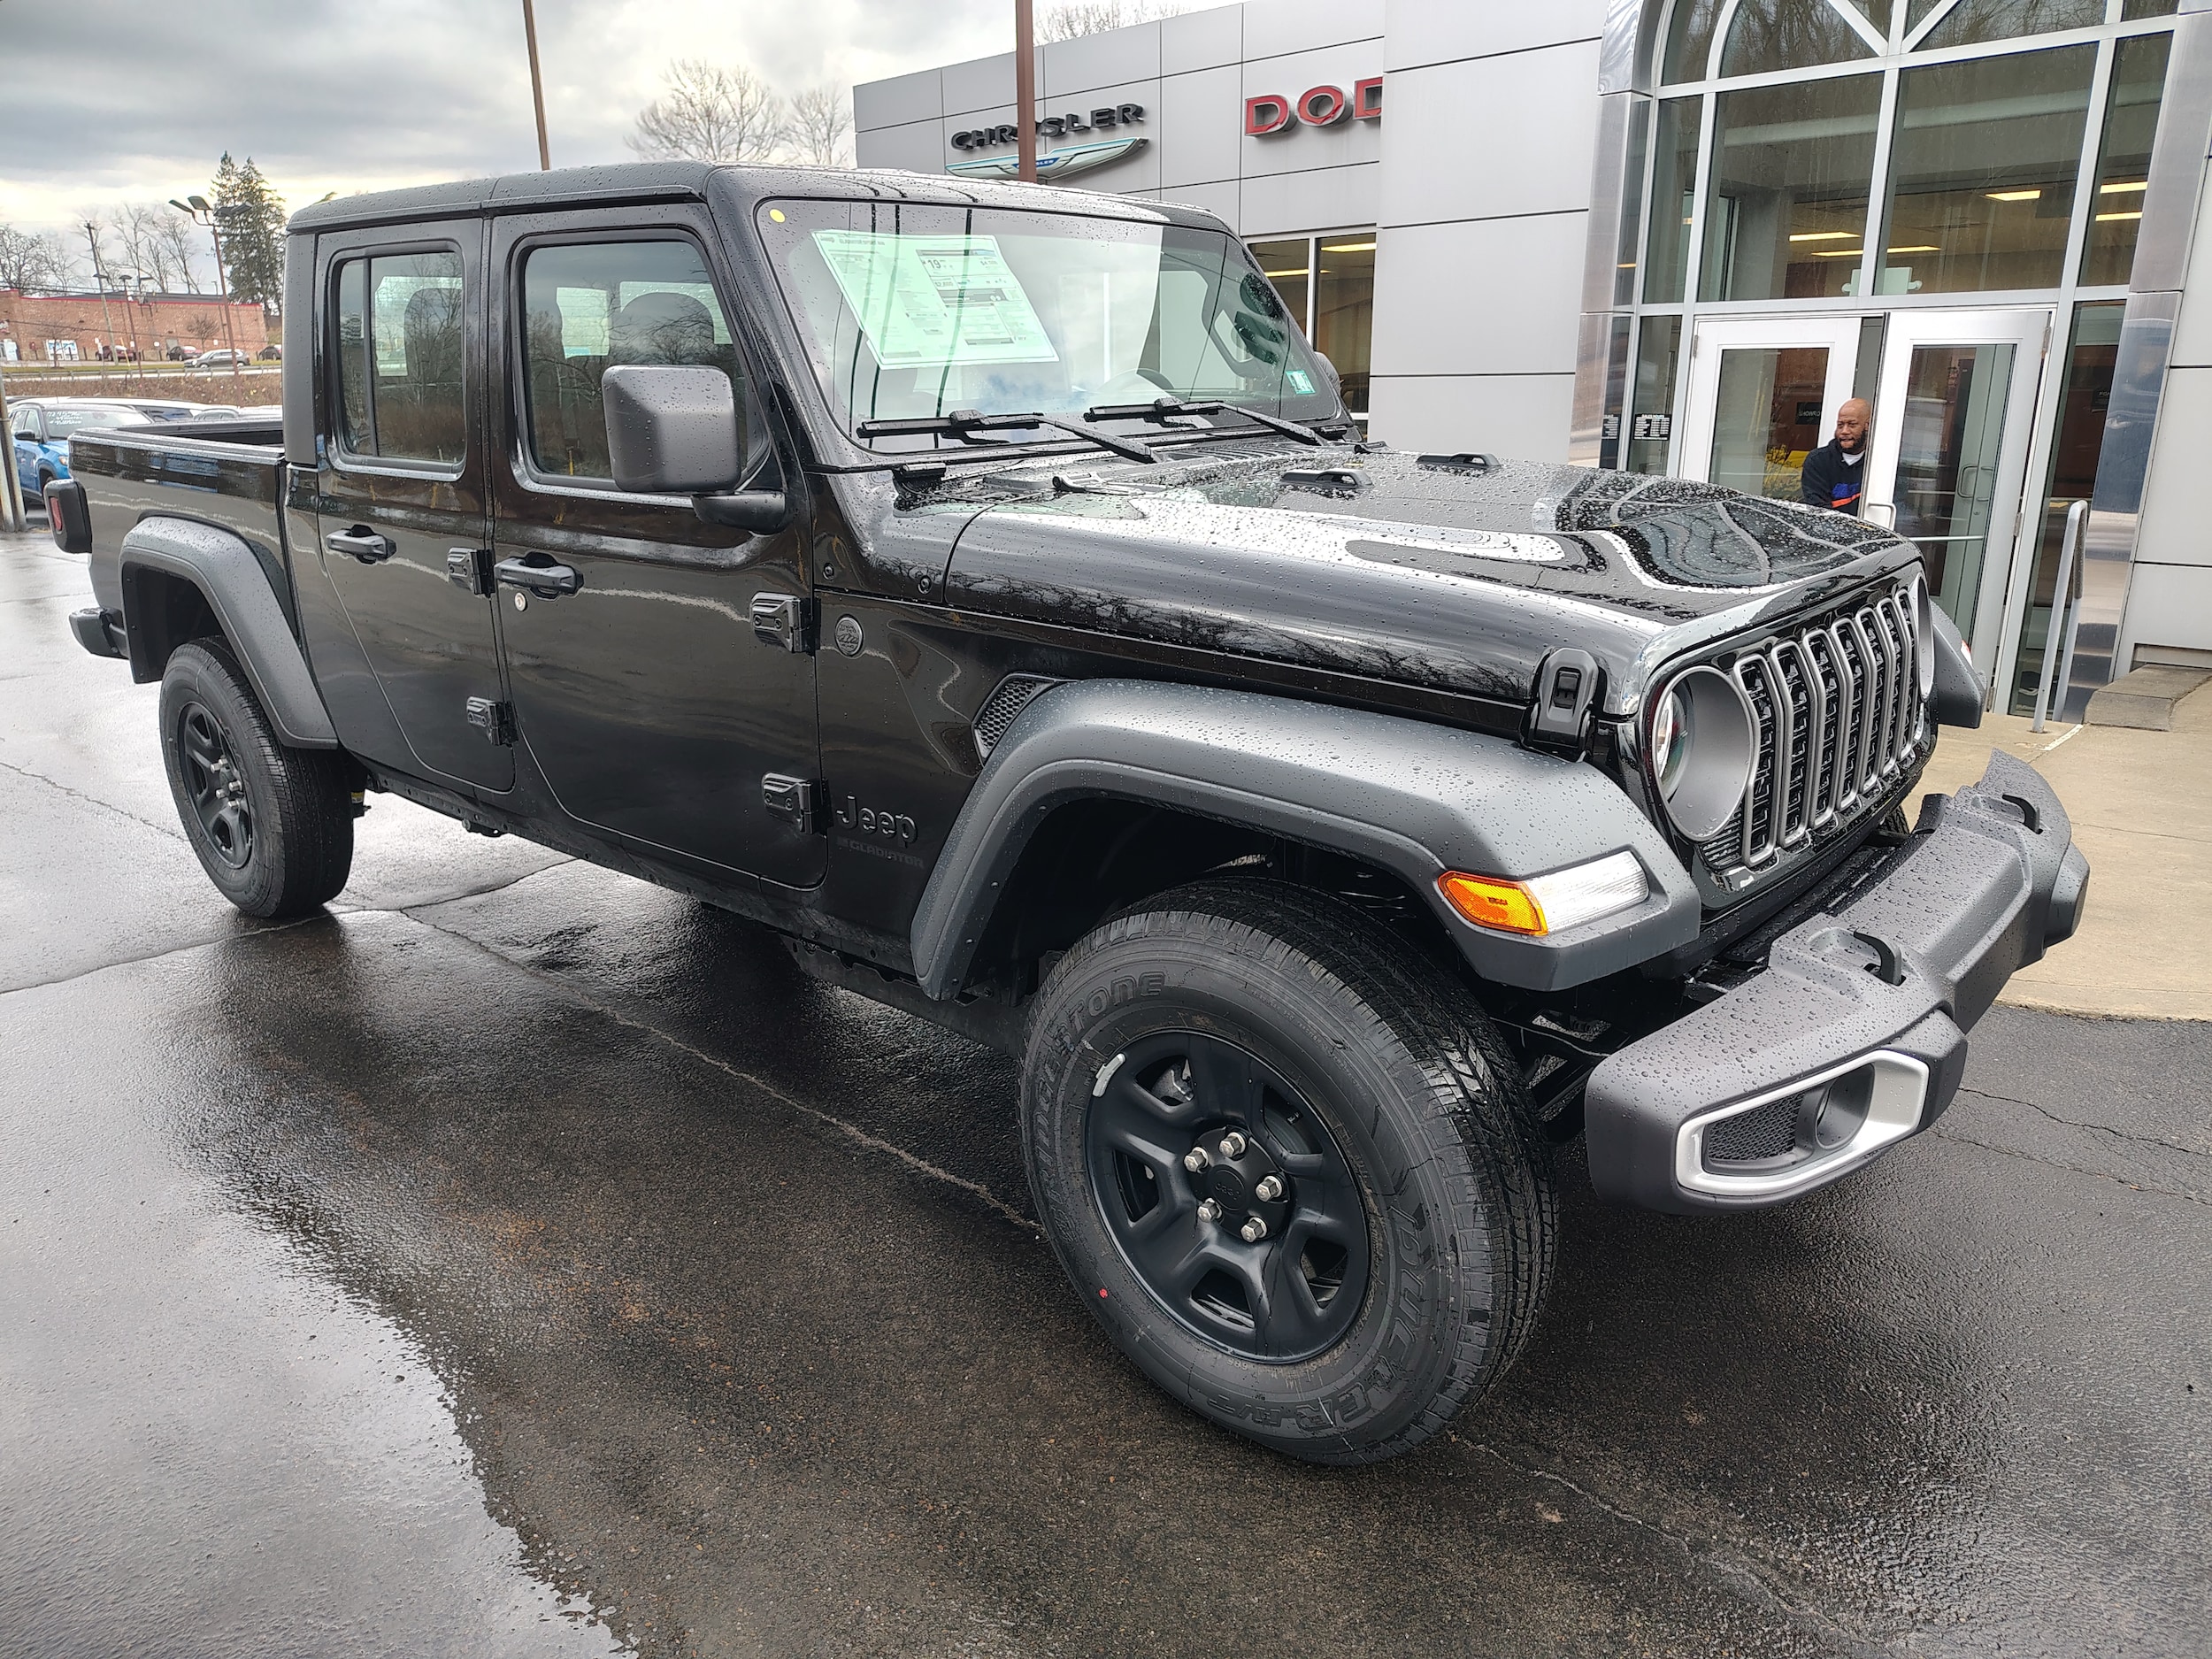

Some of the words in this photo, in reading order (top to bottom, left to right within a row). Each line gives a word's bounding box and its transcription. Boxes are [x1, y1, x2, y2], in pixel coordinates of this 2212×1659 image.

[951, 104, 1144, 150] CHRSLER
[836, 795, 918, 849] Jeep
[849, 841, 924, 867] GLADIATOR
